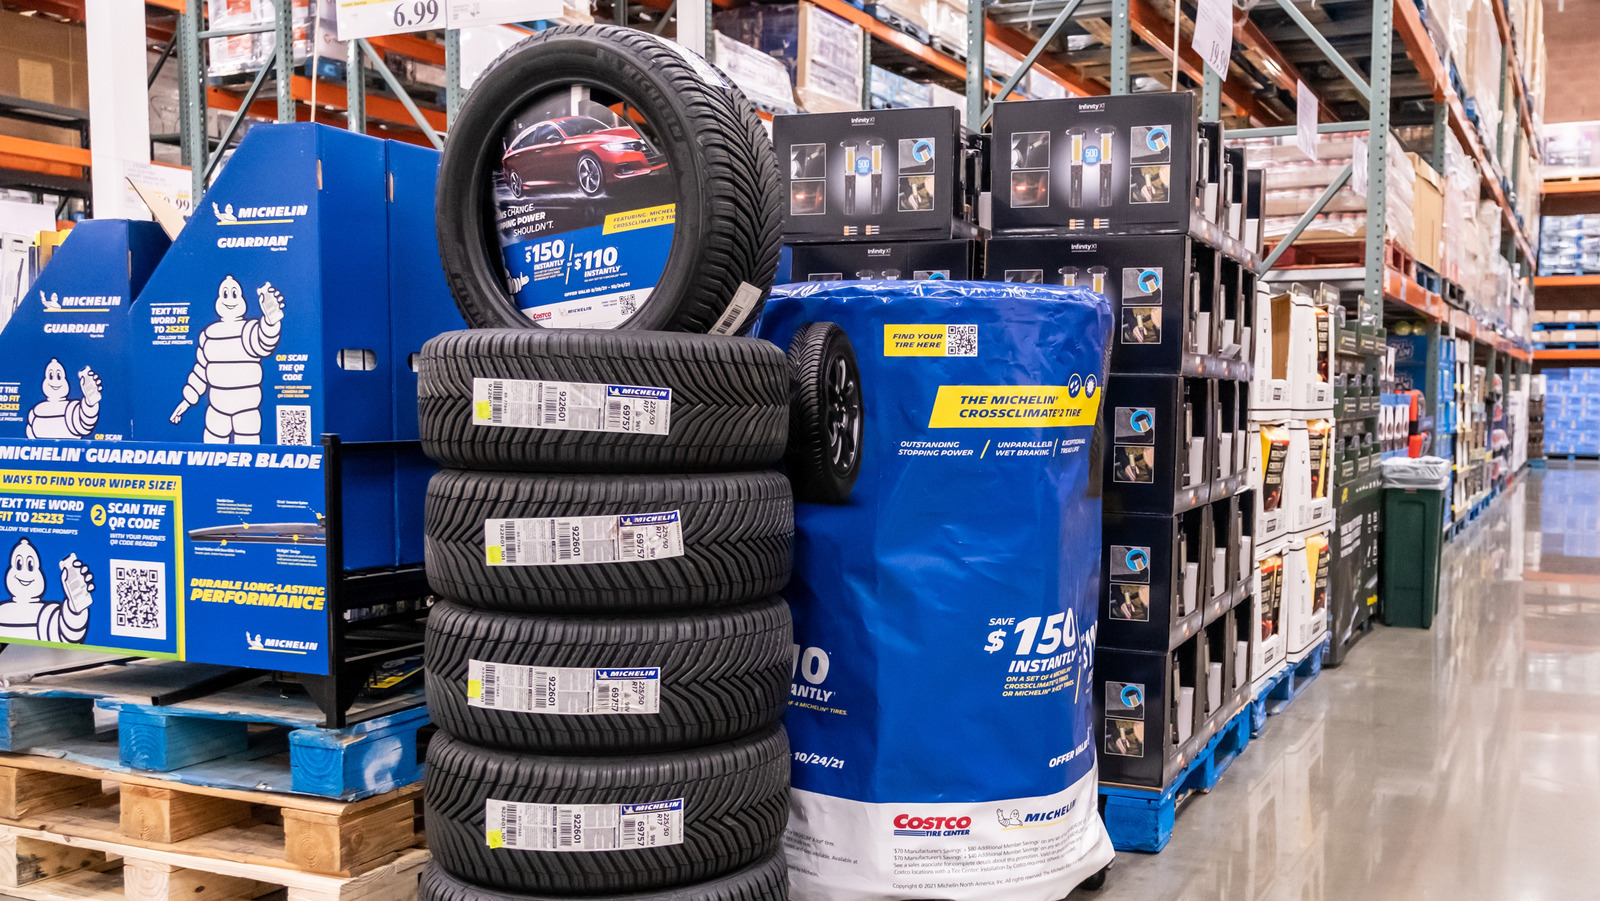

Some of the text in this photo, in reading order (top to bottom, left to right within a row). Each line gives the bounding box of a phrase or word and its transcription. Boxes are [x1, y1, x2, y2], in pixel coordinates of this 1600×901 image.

[393, 0, 439, 27] 6.99
[1085, 148, 1098, 157] 500
[857, 160, 870, 168] 500
[238, 205, 308, 218] MICHELIN
[507, 203, 535, 216] CHANGE.
[517, 211, 546, 226] POWER
[613, 212, 646, 222] FEATURING
[513, 220, 554, 237] SHOULDN'T.
[534, 258, 565, 271] INSTANTLY
[584, 265, 621, 278] INSTANTLY
[62, 296, 121, 307] MICHELIN
[151, 307, 188, 315] TEXT THE
[533, 311, 552, 320] COSTCO
[567, 306, 592, 314] MICHELIN
[150, 316, 190, 324] WORD FIT
[154, 325, 190, 333] TO 25233
[293, 364, 305, 373] QR
[5, 386, 19, 394] THE
[622, 387, 667, 397] MICHELIN
[559, 391, 567, 422] 922601
[960, 395, 989, 405] THE
[622, 404, 630, 431] 69757
[1065, 408, 1082, 417] TIRE
[900, 440, 960, 449] OUTSTANDING
[898, 448, 937, 456] STOPPING
[187, 451, 251, 467] WIPER
[255, 452, 323, 469] BLADE
[3, 474, 177, 491] WAYS TO FIND YOUR WIPER SIZE!
[25, 499, 84, 511] THE WORD
[108, 502, 167, 516] SCAN THE
[15, 512, 30, 522] TO
[31, 512, 64, 524] 25233
[94, 509, 103, 521] 2
[108, 517, 161, 531] QR CODE
[571, 526, 580, 557] 922601
[636, 533, 644, 559] 69757
[190, 578, 325, 596] DURABLE LONG-LASTING
[190, 588, 326, 610] PERFORMANCE
[988, 617, 1015, 626] SAVE
[983, 607, 1076, 655] $150
[264, 638, 318, 650] MICHELIN
[1008, 649, 1077, 673] INSTANTLY
[611, 687, 619, 712] 69757
[637, 681, 645, 705] 225/50
[830, 708, 848, 716] TIRES.
[794, 751, 845, 769] 10/24/21
[1049, 750, 1075, 768] OFFER
[635, 801, 681, 812] MICHELIN
[1024, 798, 1076, 822] MICHELIN
[893, 813, 971, 830] COSTCO
[637, 820, 645, 846] 69757
[942, 829, 970, 837] CENTER
[951, 860, 975, 868] complete
[1016, 854, 1039, 862] promotion.
[1050, 866, 1065, 874] Michelin
